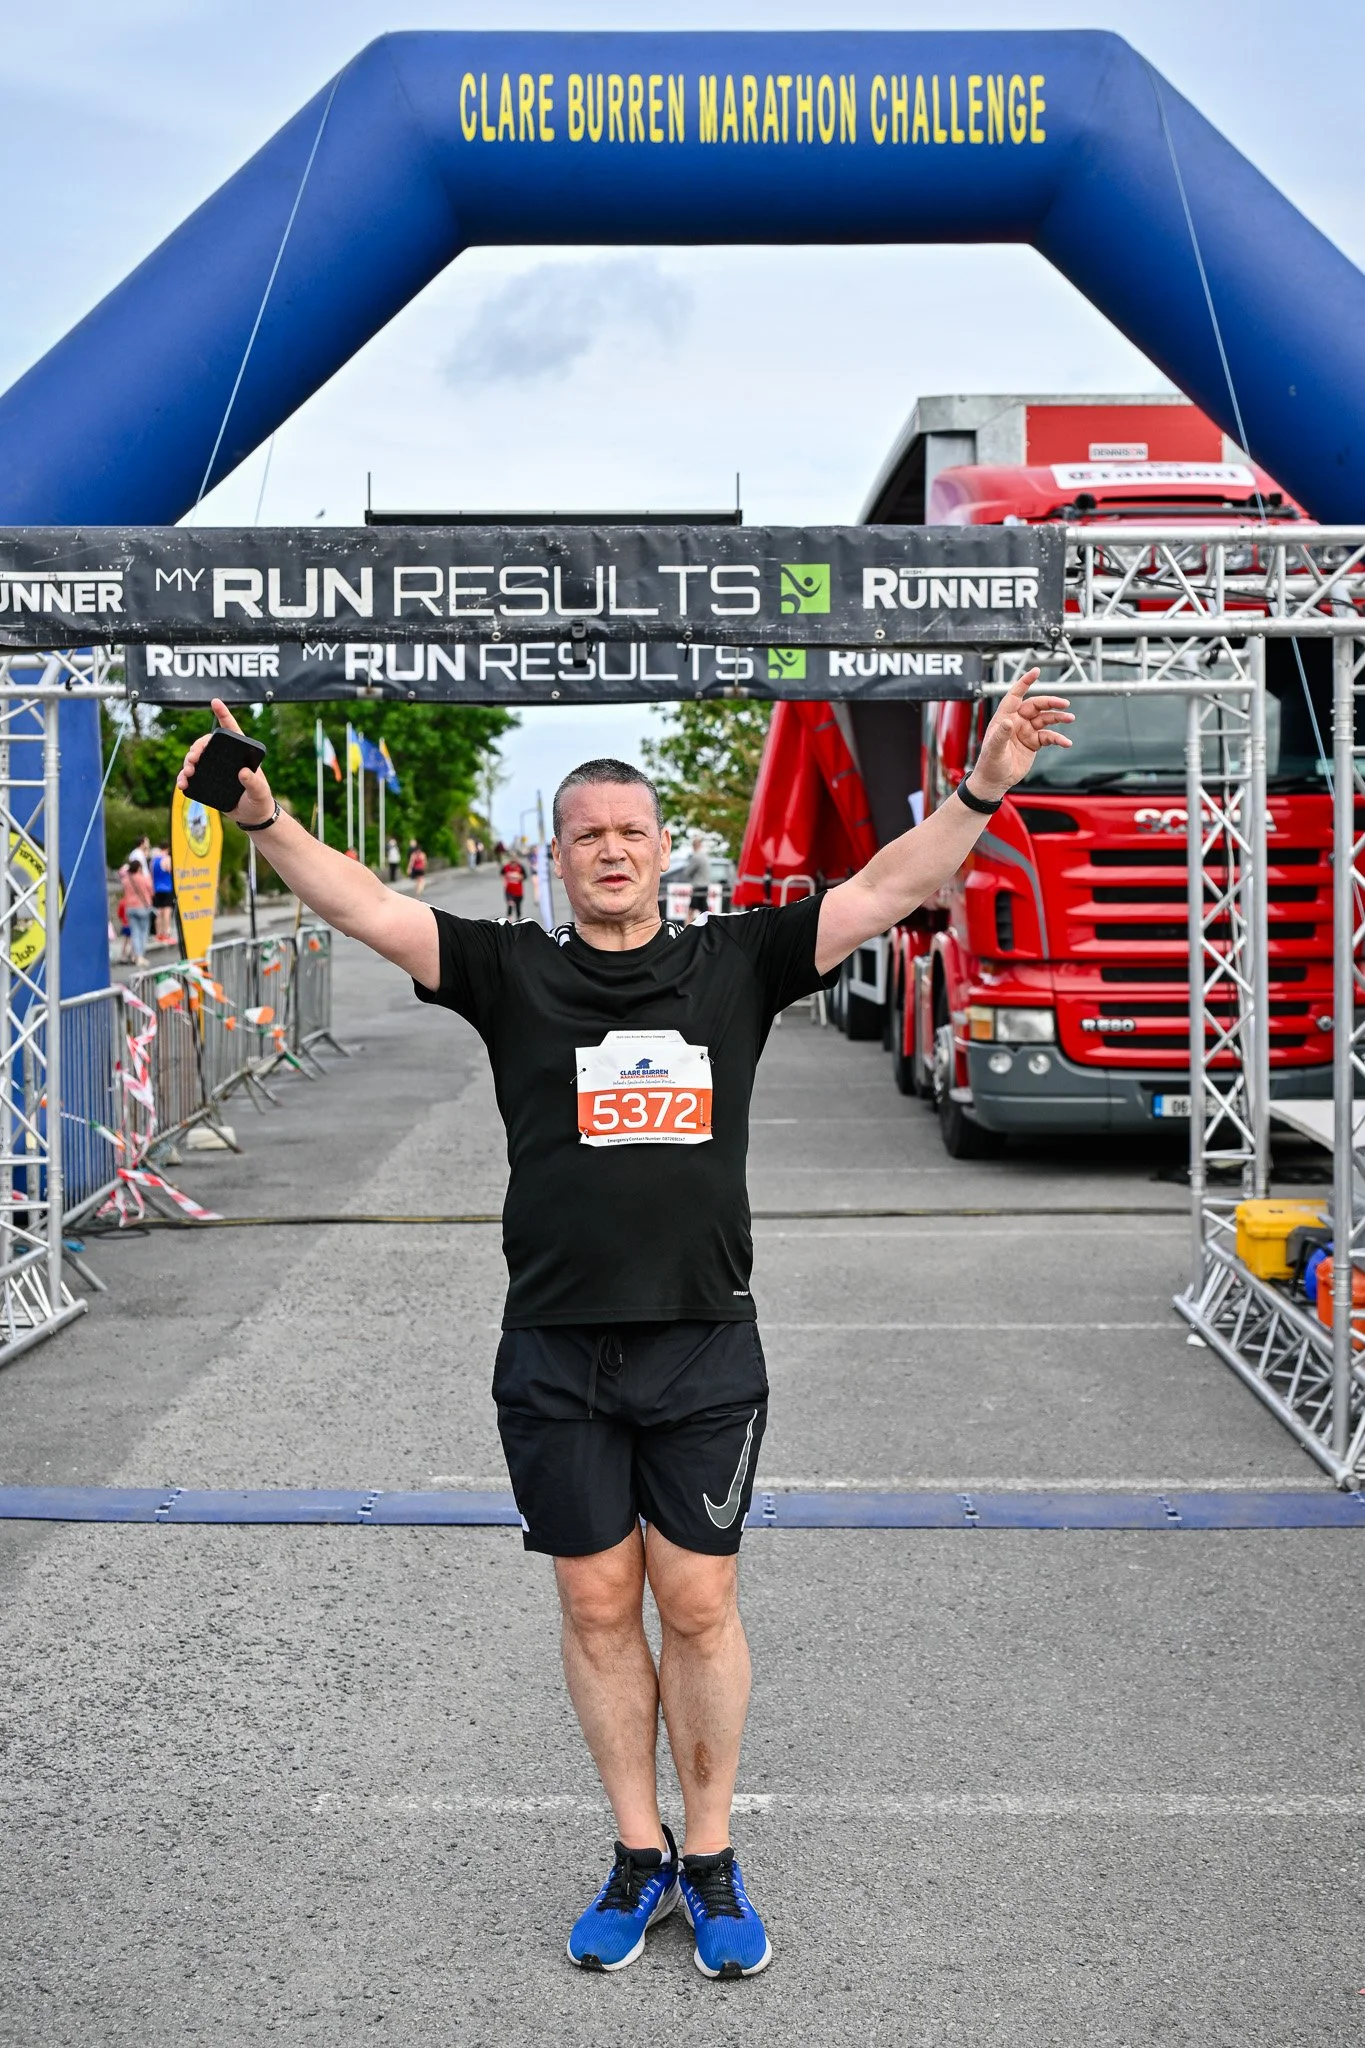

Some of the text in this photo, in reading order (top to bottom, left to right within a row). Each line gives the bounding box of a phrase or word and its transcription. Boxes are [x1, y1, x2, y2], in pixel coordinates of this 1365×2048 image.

[459, 72, 1046, 145] CLARE BURREN MARATHON CHALLENGE
[155, 564, 761, 618] MY RUN RESULTS
[863, 568, 1039, 609] RUNNER
[146, 644, 280, 678] RUNNER
[302, 643, 754, 681] MY RUN RESULTS
[829, 651, 964, 677] RUNNER
[592, 1091, 697, 1131] 5372
